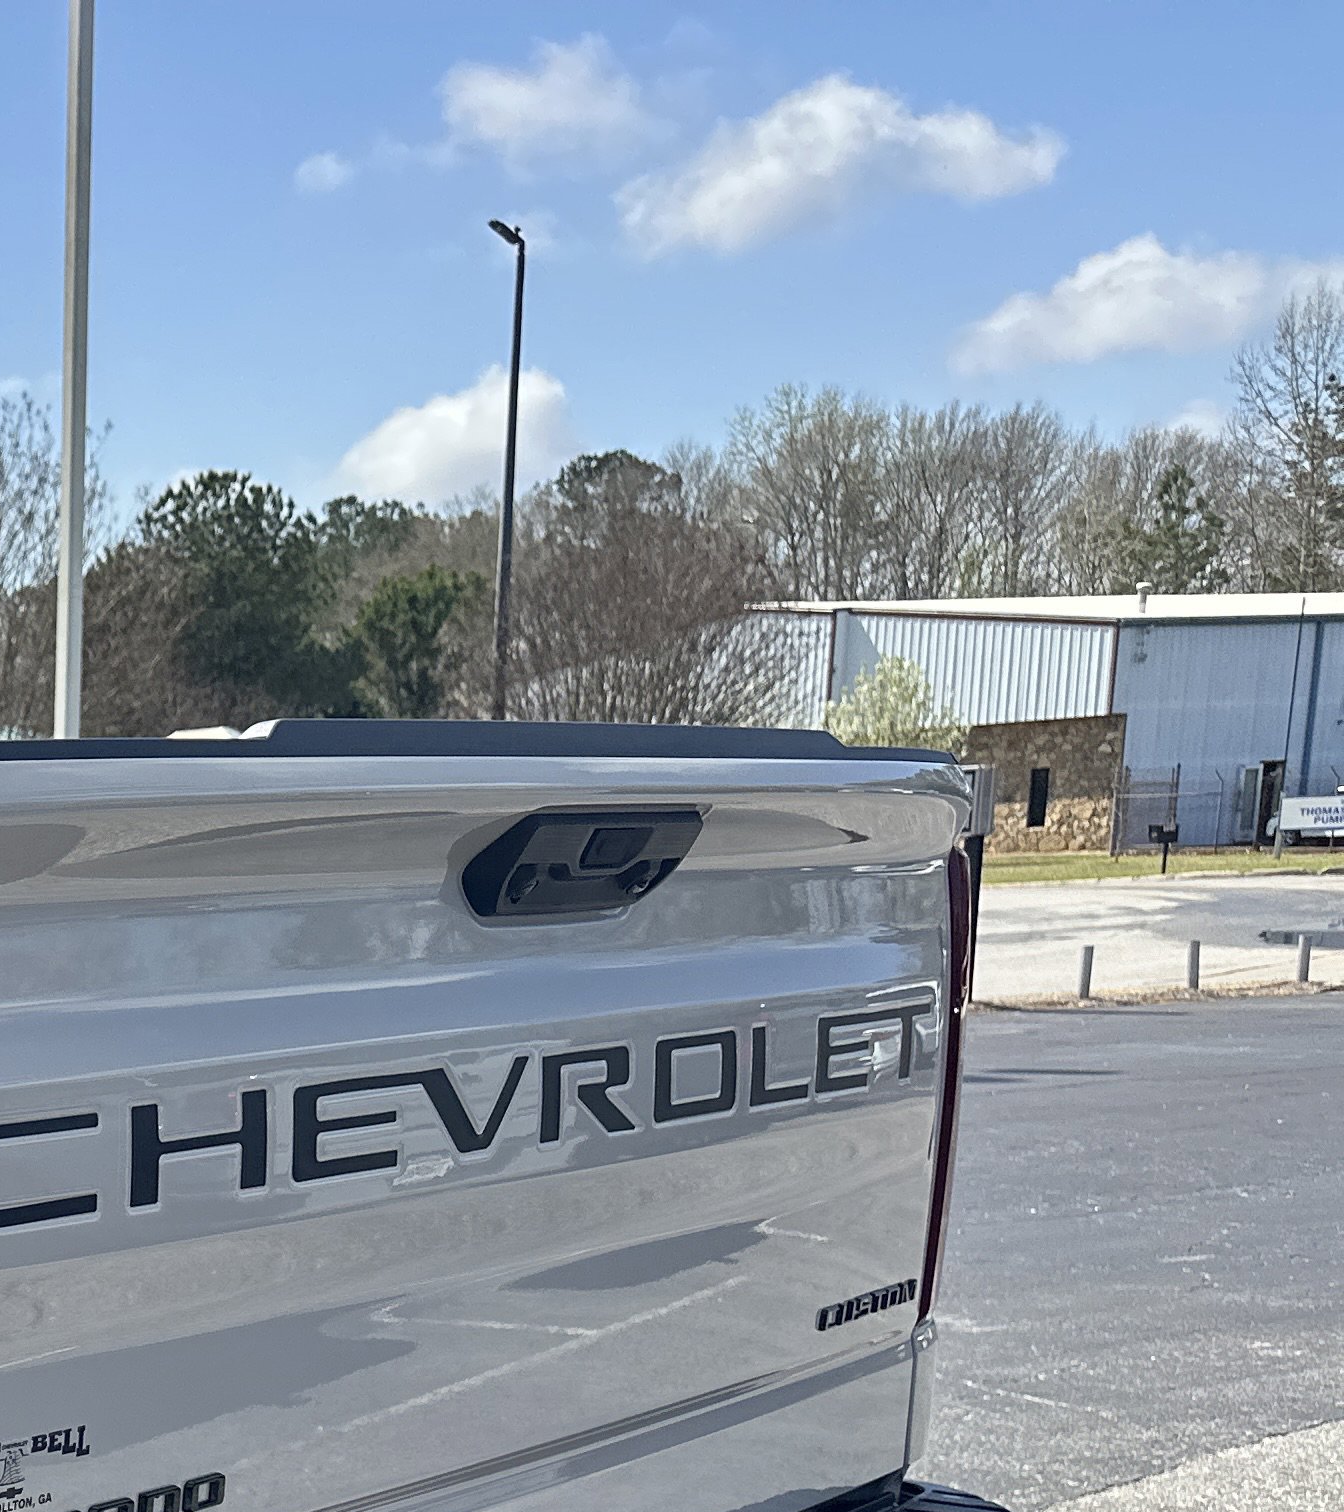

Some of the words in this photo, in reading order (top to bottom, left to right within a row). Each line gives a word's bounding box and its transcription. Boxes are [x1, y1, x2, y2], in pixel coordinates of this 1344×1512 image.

[815, 1279, 917, 1331] CUSTOM
[31, 1425, 90, 1457] BELL
[39, 1493, 52, 1505] GA
